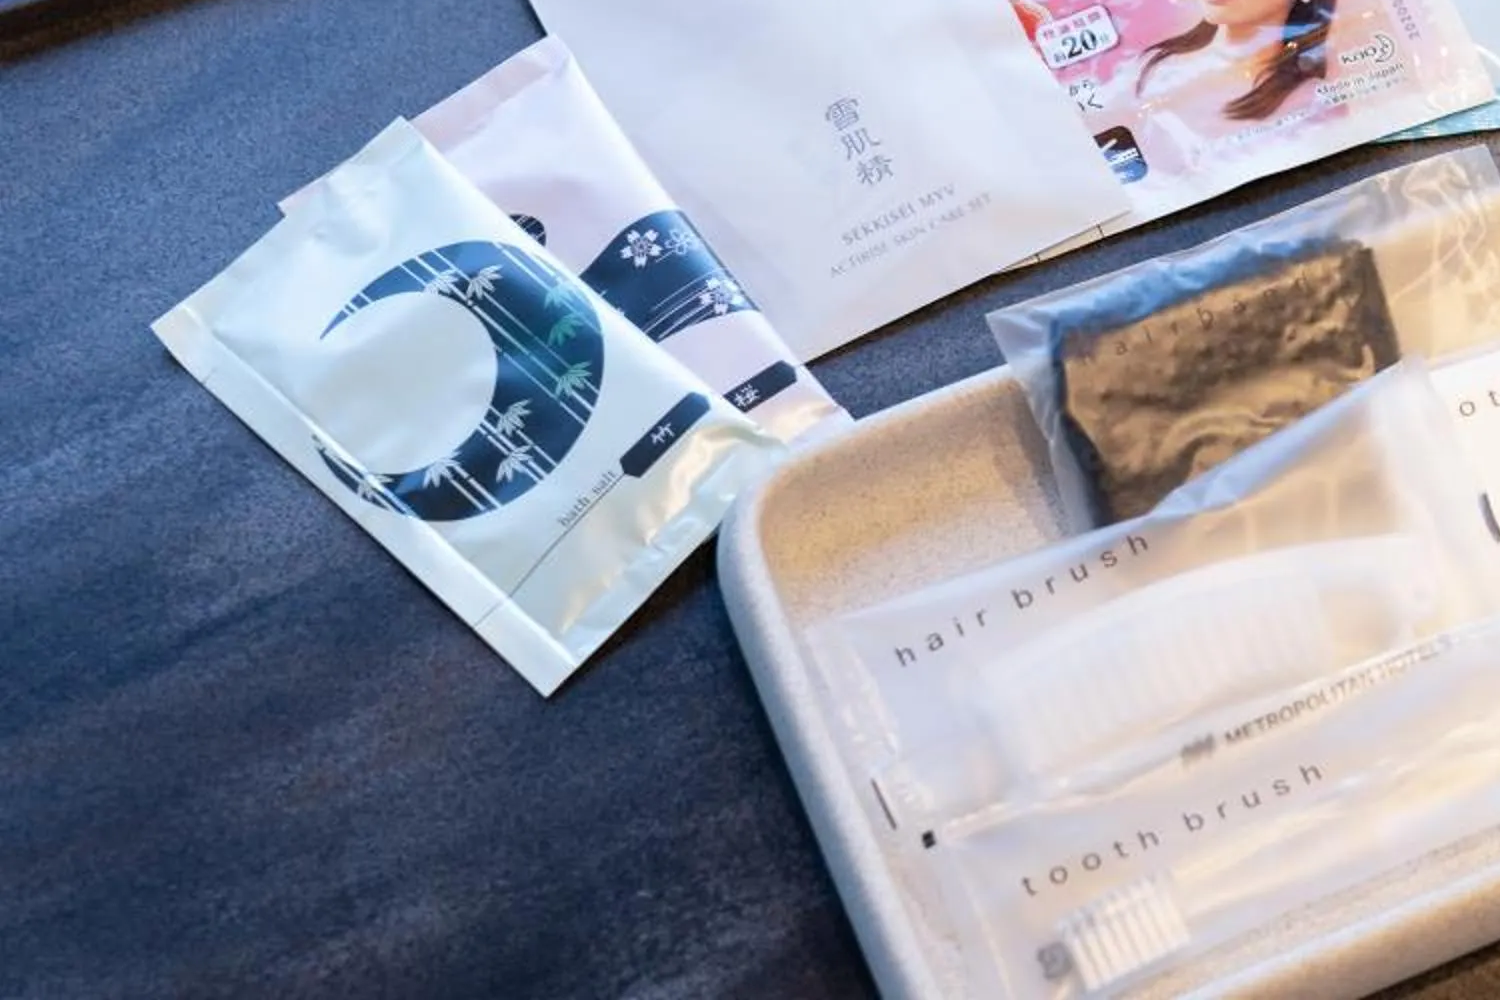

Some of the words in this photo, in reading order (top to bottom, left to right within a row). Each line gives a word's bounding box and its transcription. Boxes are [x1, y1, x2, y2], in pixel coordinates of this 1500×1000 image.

[825, 98, 894, 186] 雪肌精
[650, 423, 675, 445] 竹
[893, 608, 988, 667] hair
[1011, 533, 1149, 610] brush
[1021, 829, 1161, 897] tooth
[1182, 763, 1324, 833] brush
